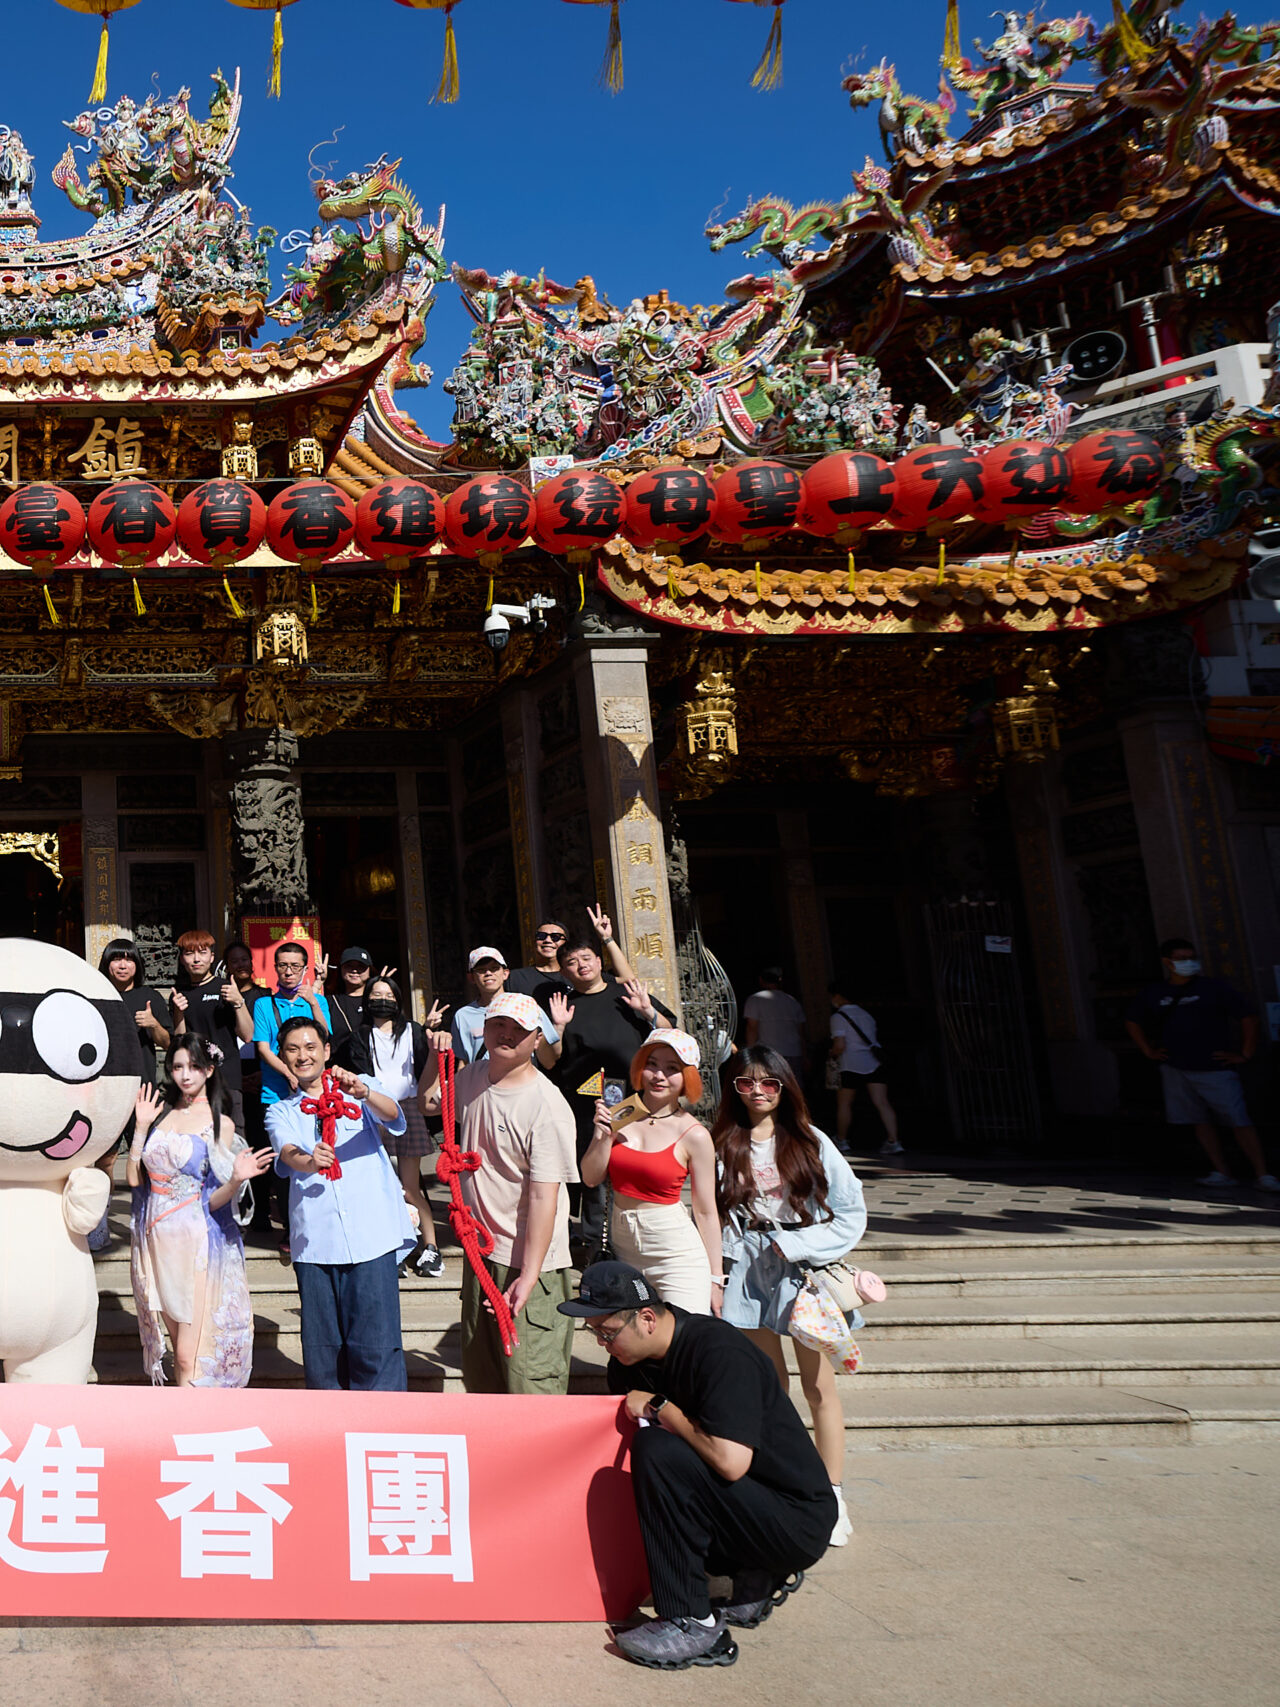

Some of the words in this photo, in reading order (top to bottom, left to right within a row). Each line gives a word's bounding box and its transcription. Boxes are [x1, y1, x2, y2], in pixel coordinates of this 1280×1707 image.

[624, 797, 664, 960] 風調雨順
[270, 927, 311, 940] 歡迎
